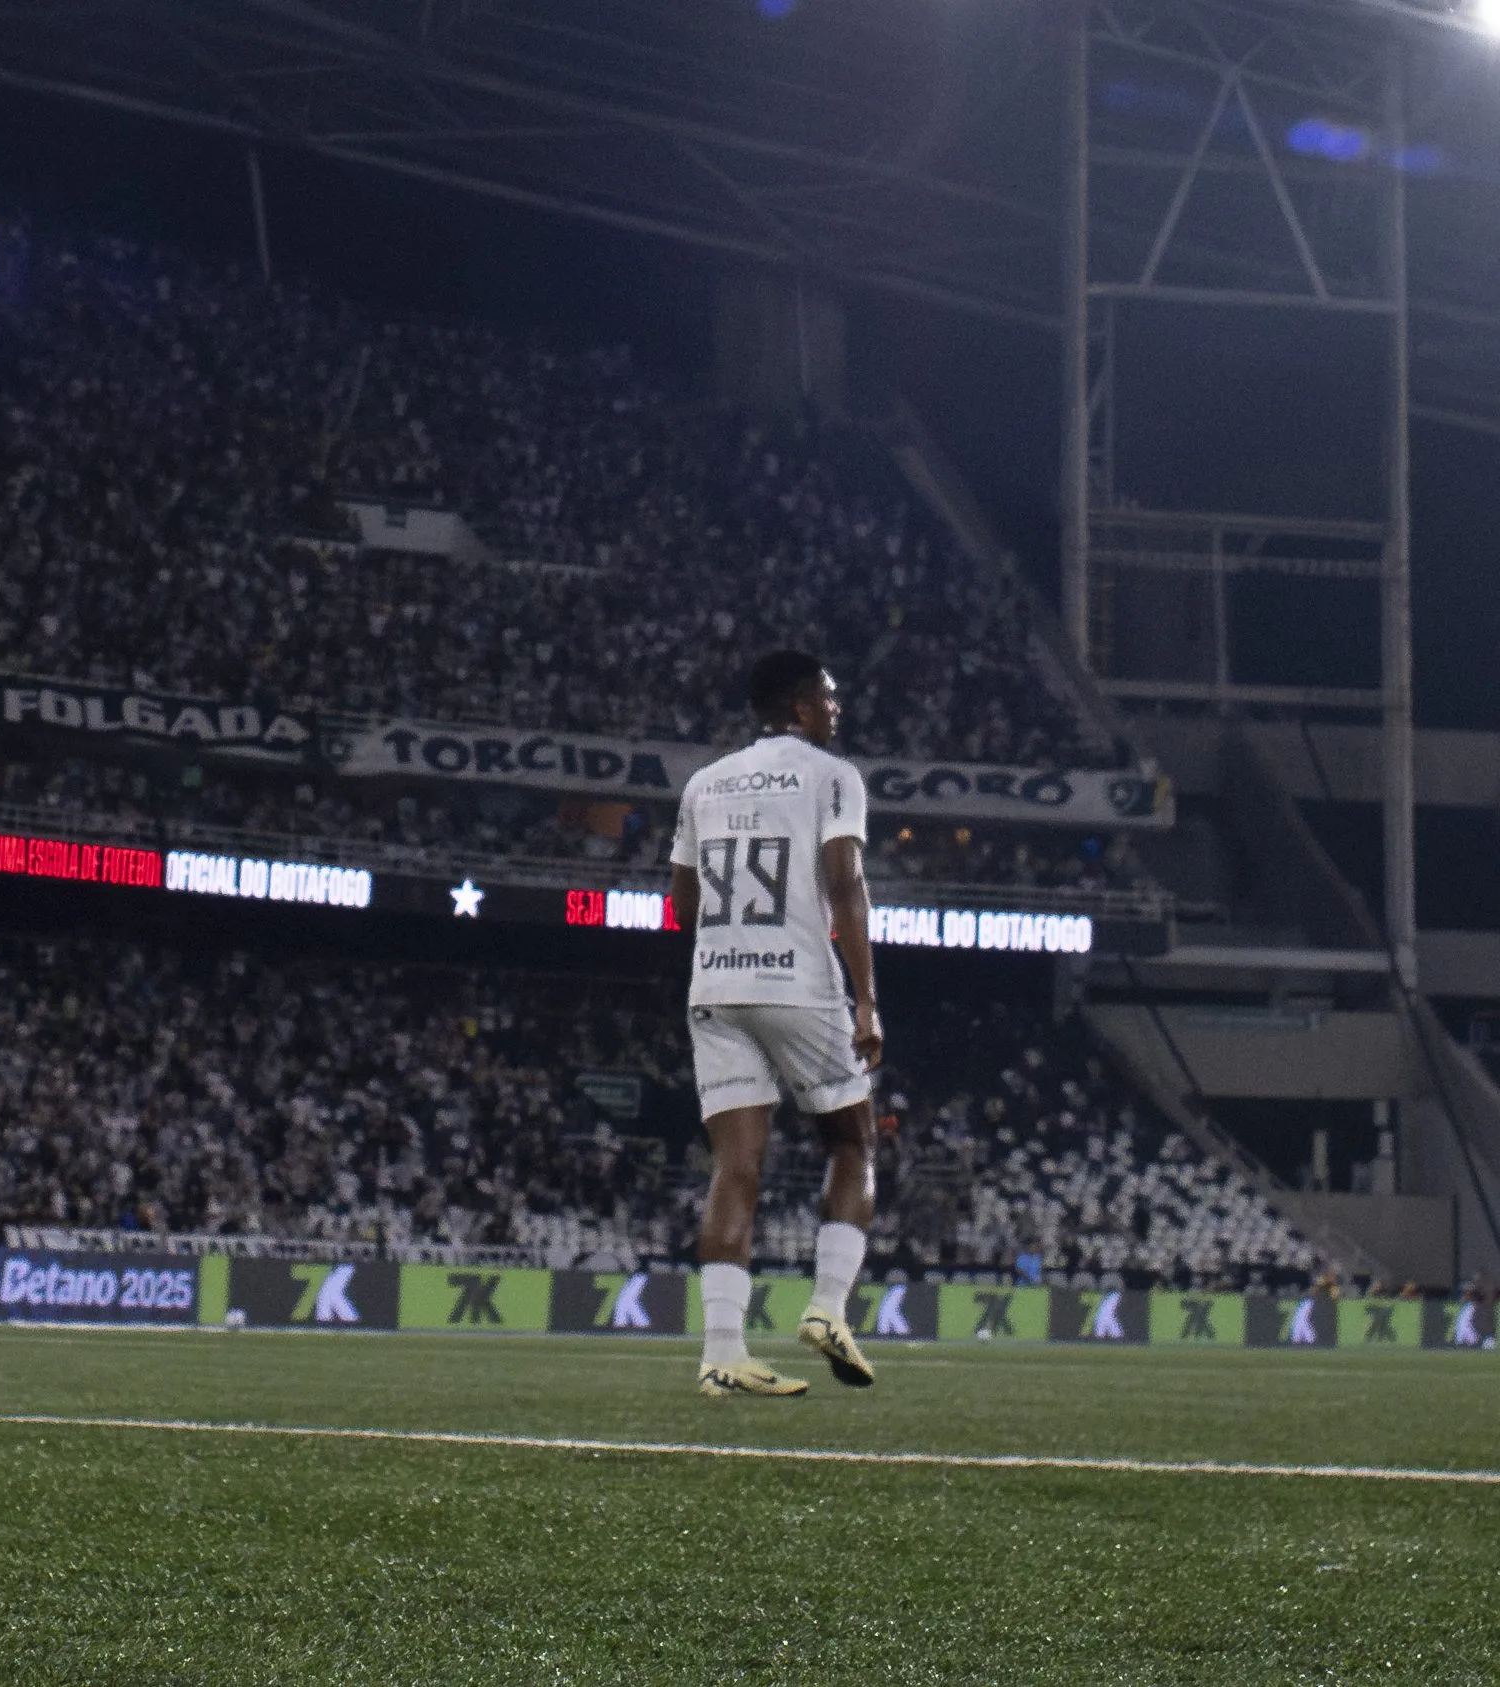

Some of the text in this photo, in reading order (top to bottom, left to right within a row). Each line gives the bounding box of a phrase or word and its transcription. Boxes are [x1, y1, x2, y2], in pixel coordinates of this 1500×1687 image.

[3, 688, 310, 742] FOLGADA
[384, 729, 674, 788] TORCIDA
[28, 838, 79, 880] ESCOLA
[81, 844, 100, 881] DE
[166, 852, 238, 896] OFICIAL
[240, 858, 268, 899] DO
[269, 861, 372, 908] BOTAFOGO
[701, 837, 790, 926] 99
[565, 890, 605, 927] SEJA
[606, 890, 664, 930] DONO
[943, 910, 977, 948] DO
[978, 911, 1092, 953] BOTAFOGO
[702, 948, 795, 970] Unimed
[1, 1257, 116, 1307] Betano
[120, 1269, 192, 1308] 2025
[291, 1264, 360, 1322] 7K
[446, 1273, 504, 1325] 7K
[594, 1273, 651, 1328] 7K
[857, 1284, 910, 1335] 7K
[1079, 1291, 1124, 1337] 7K
